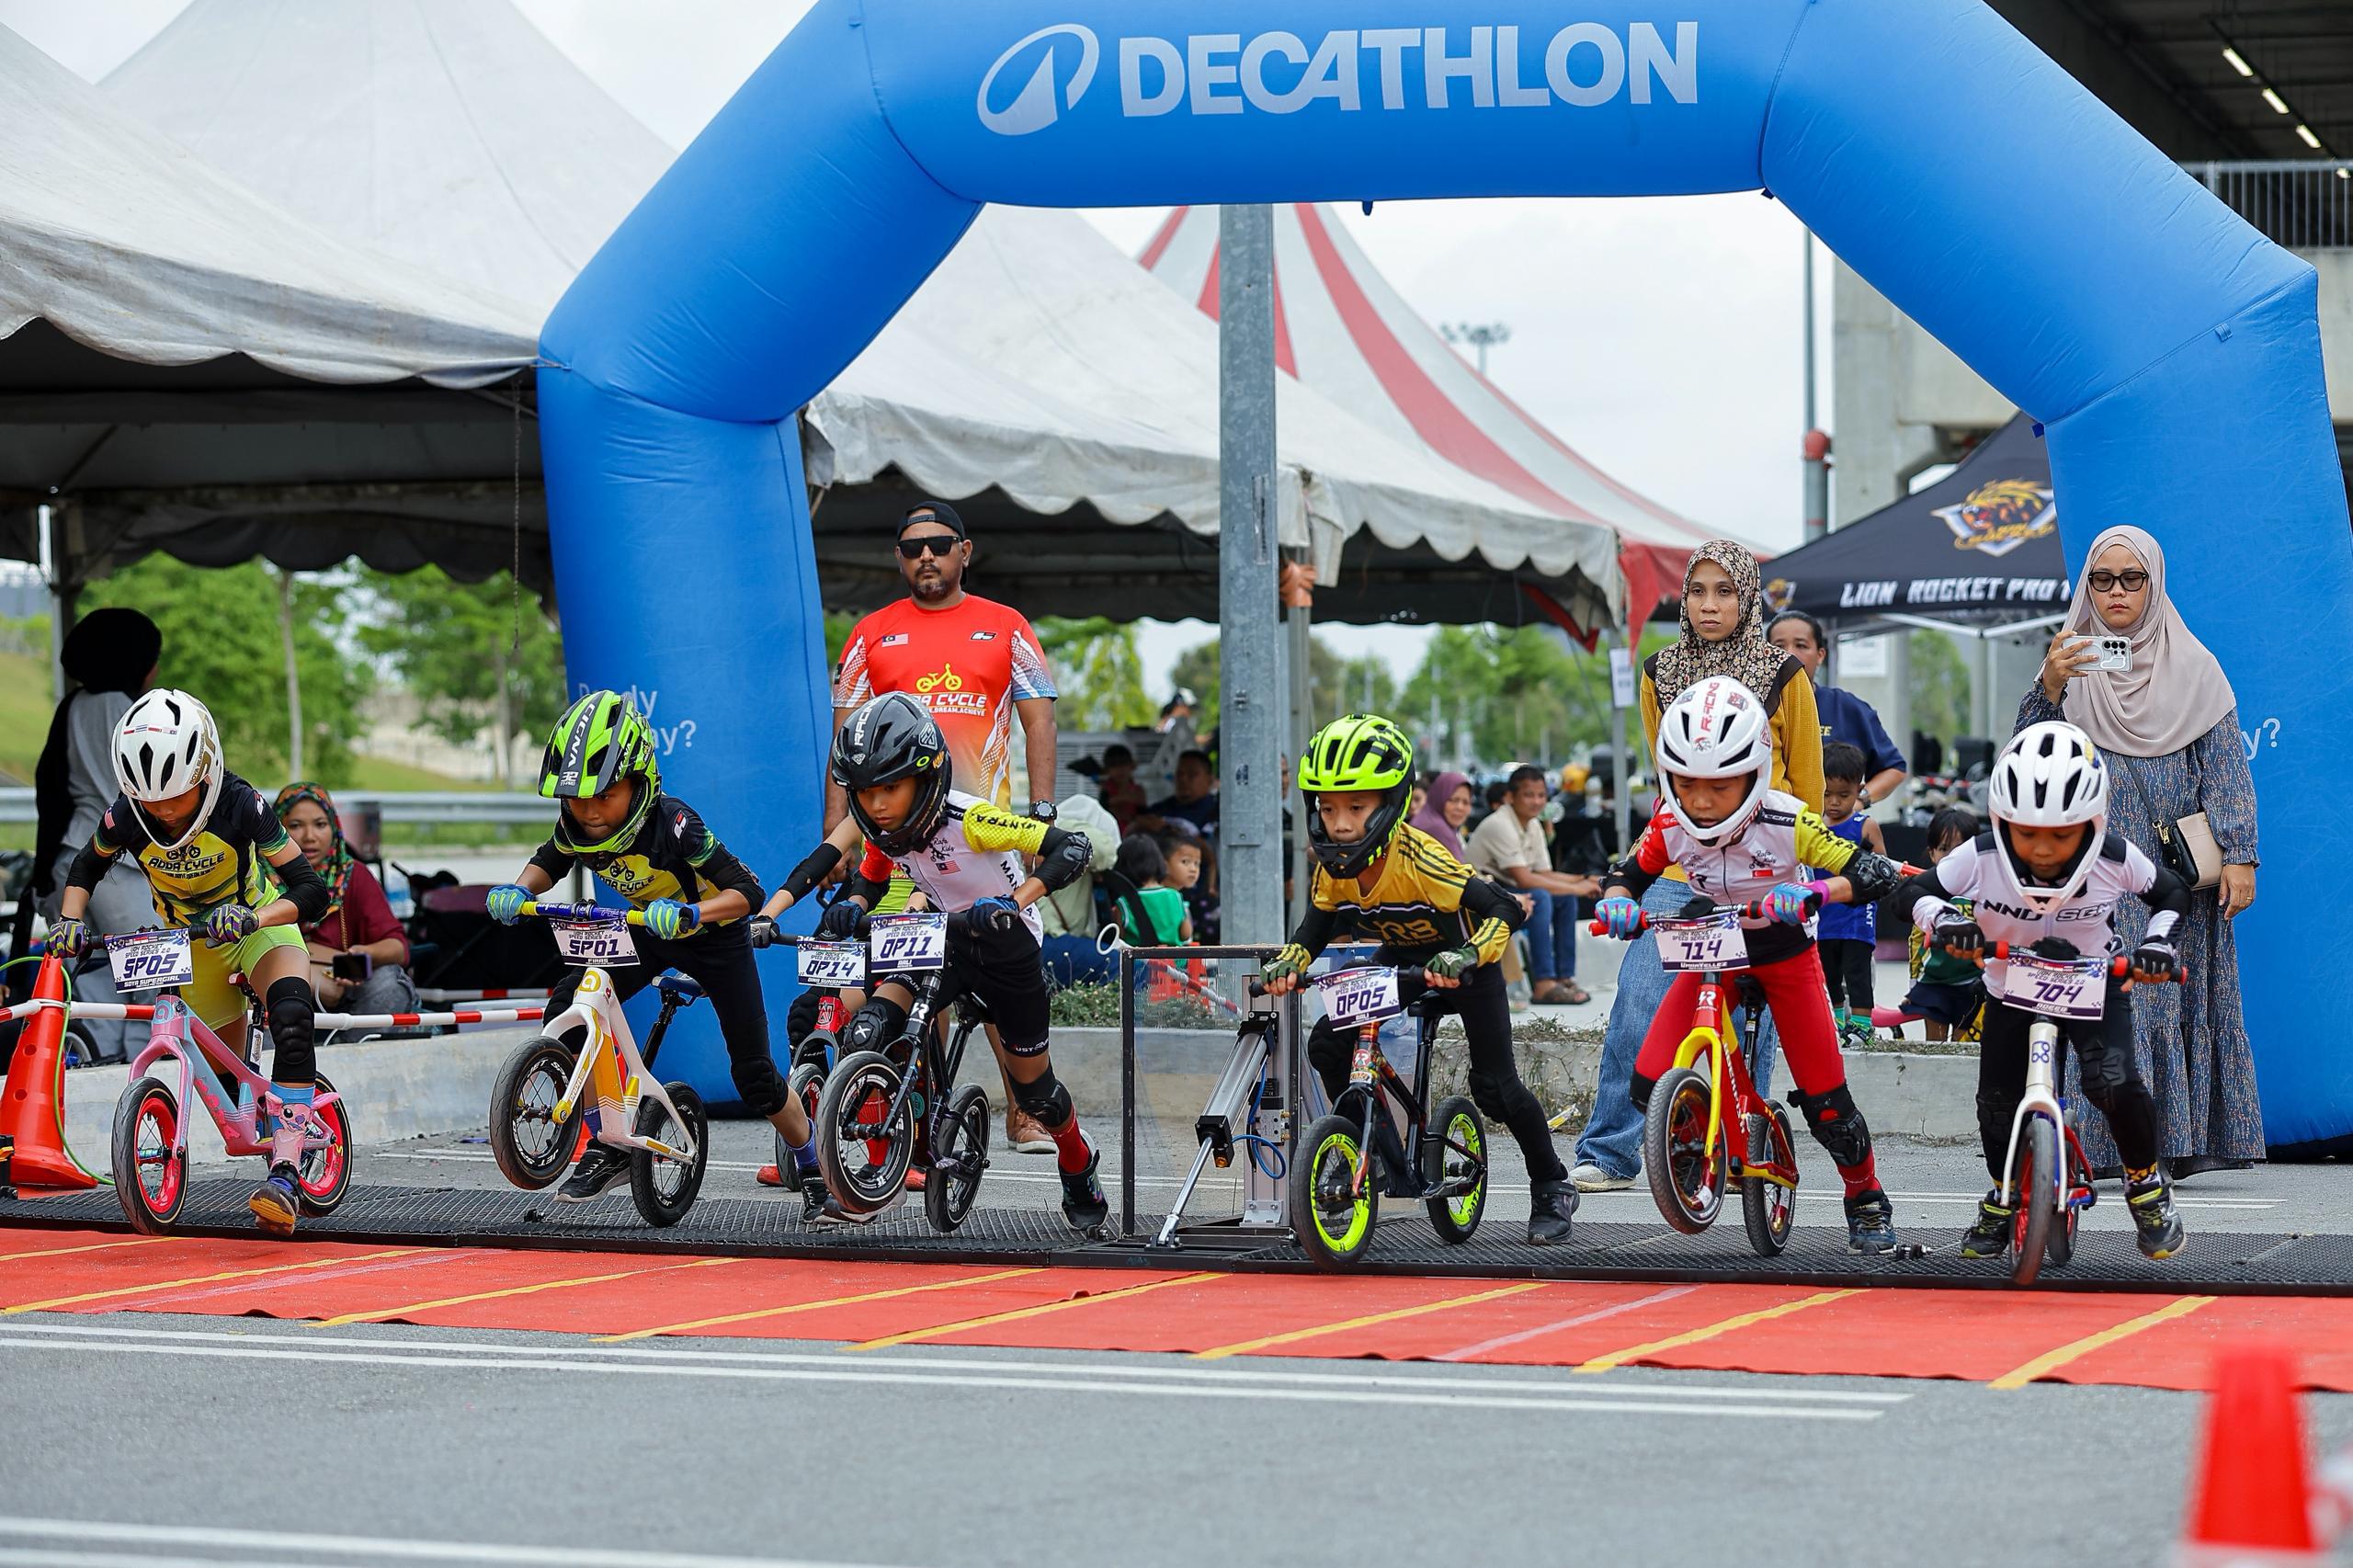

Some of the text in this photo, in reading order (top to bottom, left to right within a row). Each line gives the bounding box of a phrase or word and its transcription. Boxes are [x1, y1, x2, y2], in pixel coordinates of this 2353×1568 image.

[1119, 21, 1698, 118] DECATHLON
[1839, 579, 1899, 608] LION
[1906, 576, 2006, 605] ROCKET
[2006, 577, 2057, 602] PRO
[936, 693, 987, 708] CYCLE
[569, 938, 620, 956] SP01
[1681, 939, 1722, 960] 714
[123, 952, 180, 979] SP05
[139, 975, 180, 984] SUPERGIRL
[2034, 981, 2084, 1004] 704
